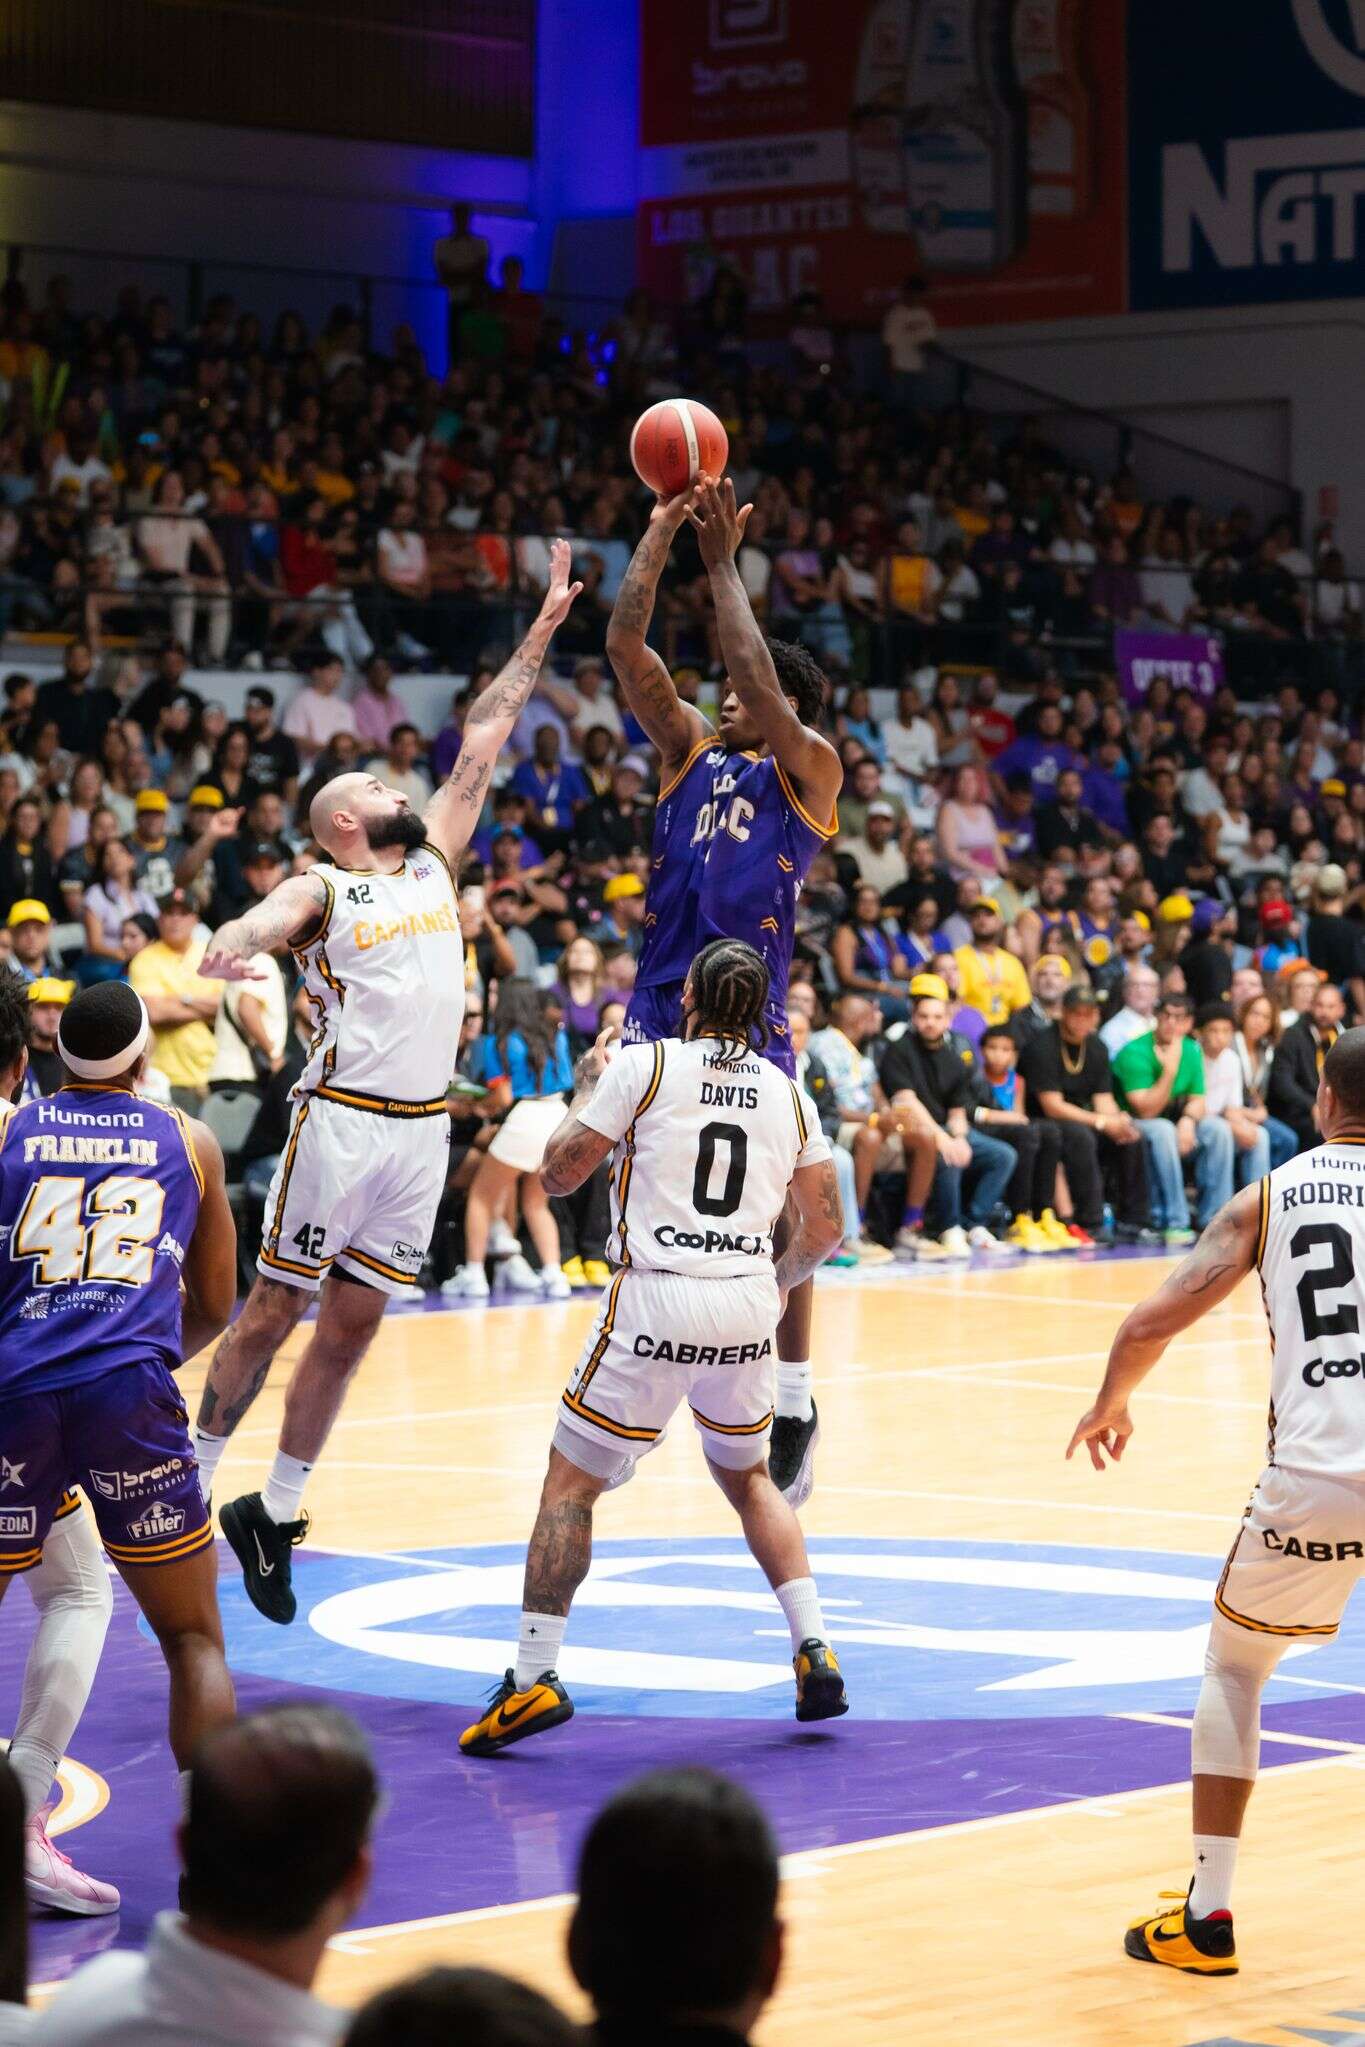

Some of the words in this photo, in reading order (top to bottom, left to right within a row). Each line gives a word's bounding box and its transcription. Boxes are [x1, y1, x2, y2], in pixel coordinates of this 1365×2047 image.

[346, 883, 374, 905] 42
[699, 1081, 758, 1110] DAVIS
[38, 1105, 144, 1128] Humana
[23, 1134, 158, 1167] FRANKLIN
[1312, 1155, 1365, 1173] Hum
[692, 1121, 748, 1218] 0
[1282, 1182, 1365, 1213] RODRI
[9, 1175, 166, 1289] 42
[292, 1222, 326, 1260] 42
[55, 1290, 127, 1305] CARIBBEAN
[1289, 1222, 1360, 1342] 2
[633, 1334, 772, 1366] CABRERA
[1302, 1352, 1365, 1388] Coo
[124, 1472, 187, 1500] lubricants
[130, 1514, 184, 1539] Filler
[1262, 1528, 1364, 1562] CABR
